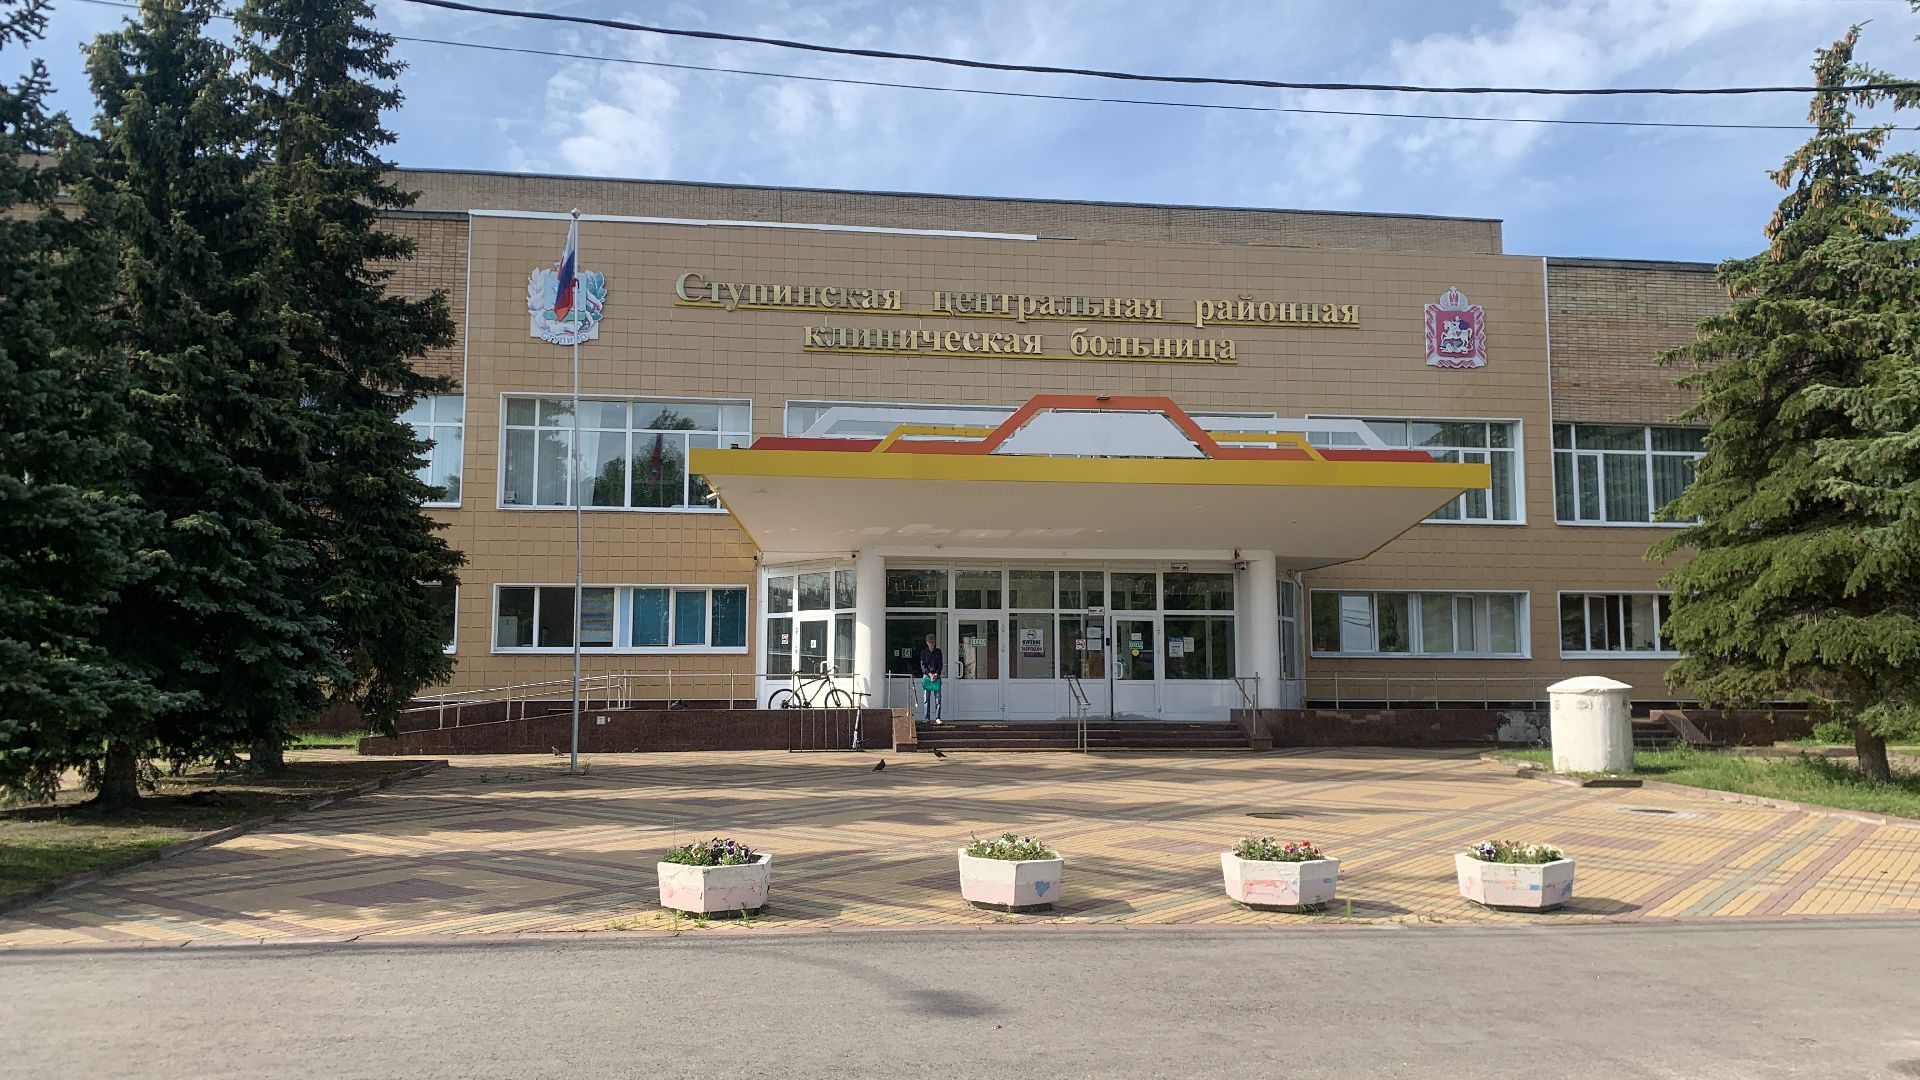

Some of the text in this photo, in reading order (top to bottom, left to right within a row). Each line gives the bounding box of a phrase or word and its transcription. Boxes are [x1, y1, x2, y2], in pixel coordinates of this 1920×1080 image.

[675, 273, 1361, 328] Ступинская центральная районная
[541, 331, 588, 344] СТУПИО
[803, 325, 1237, 364] клиническая больница
